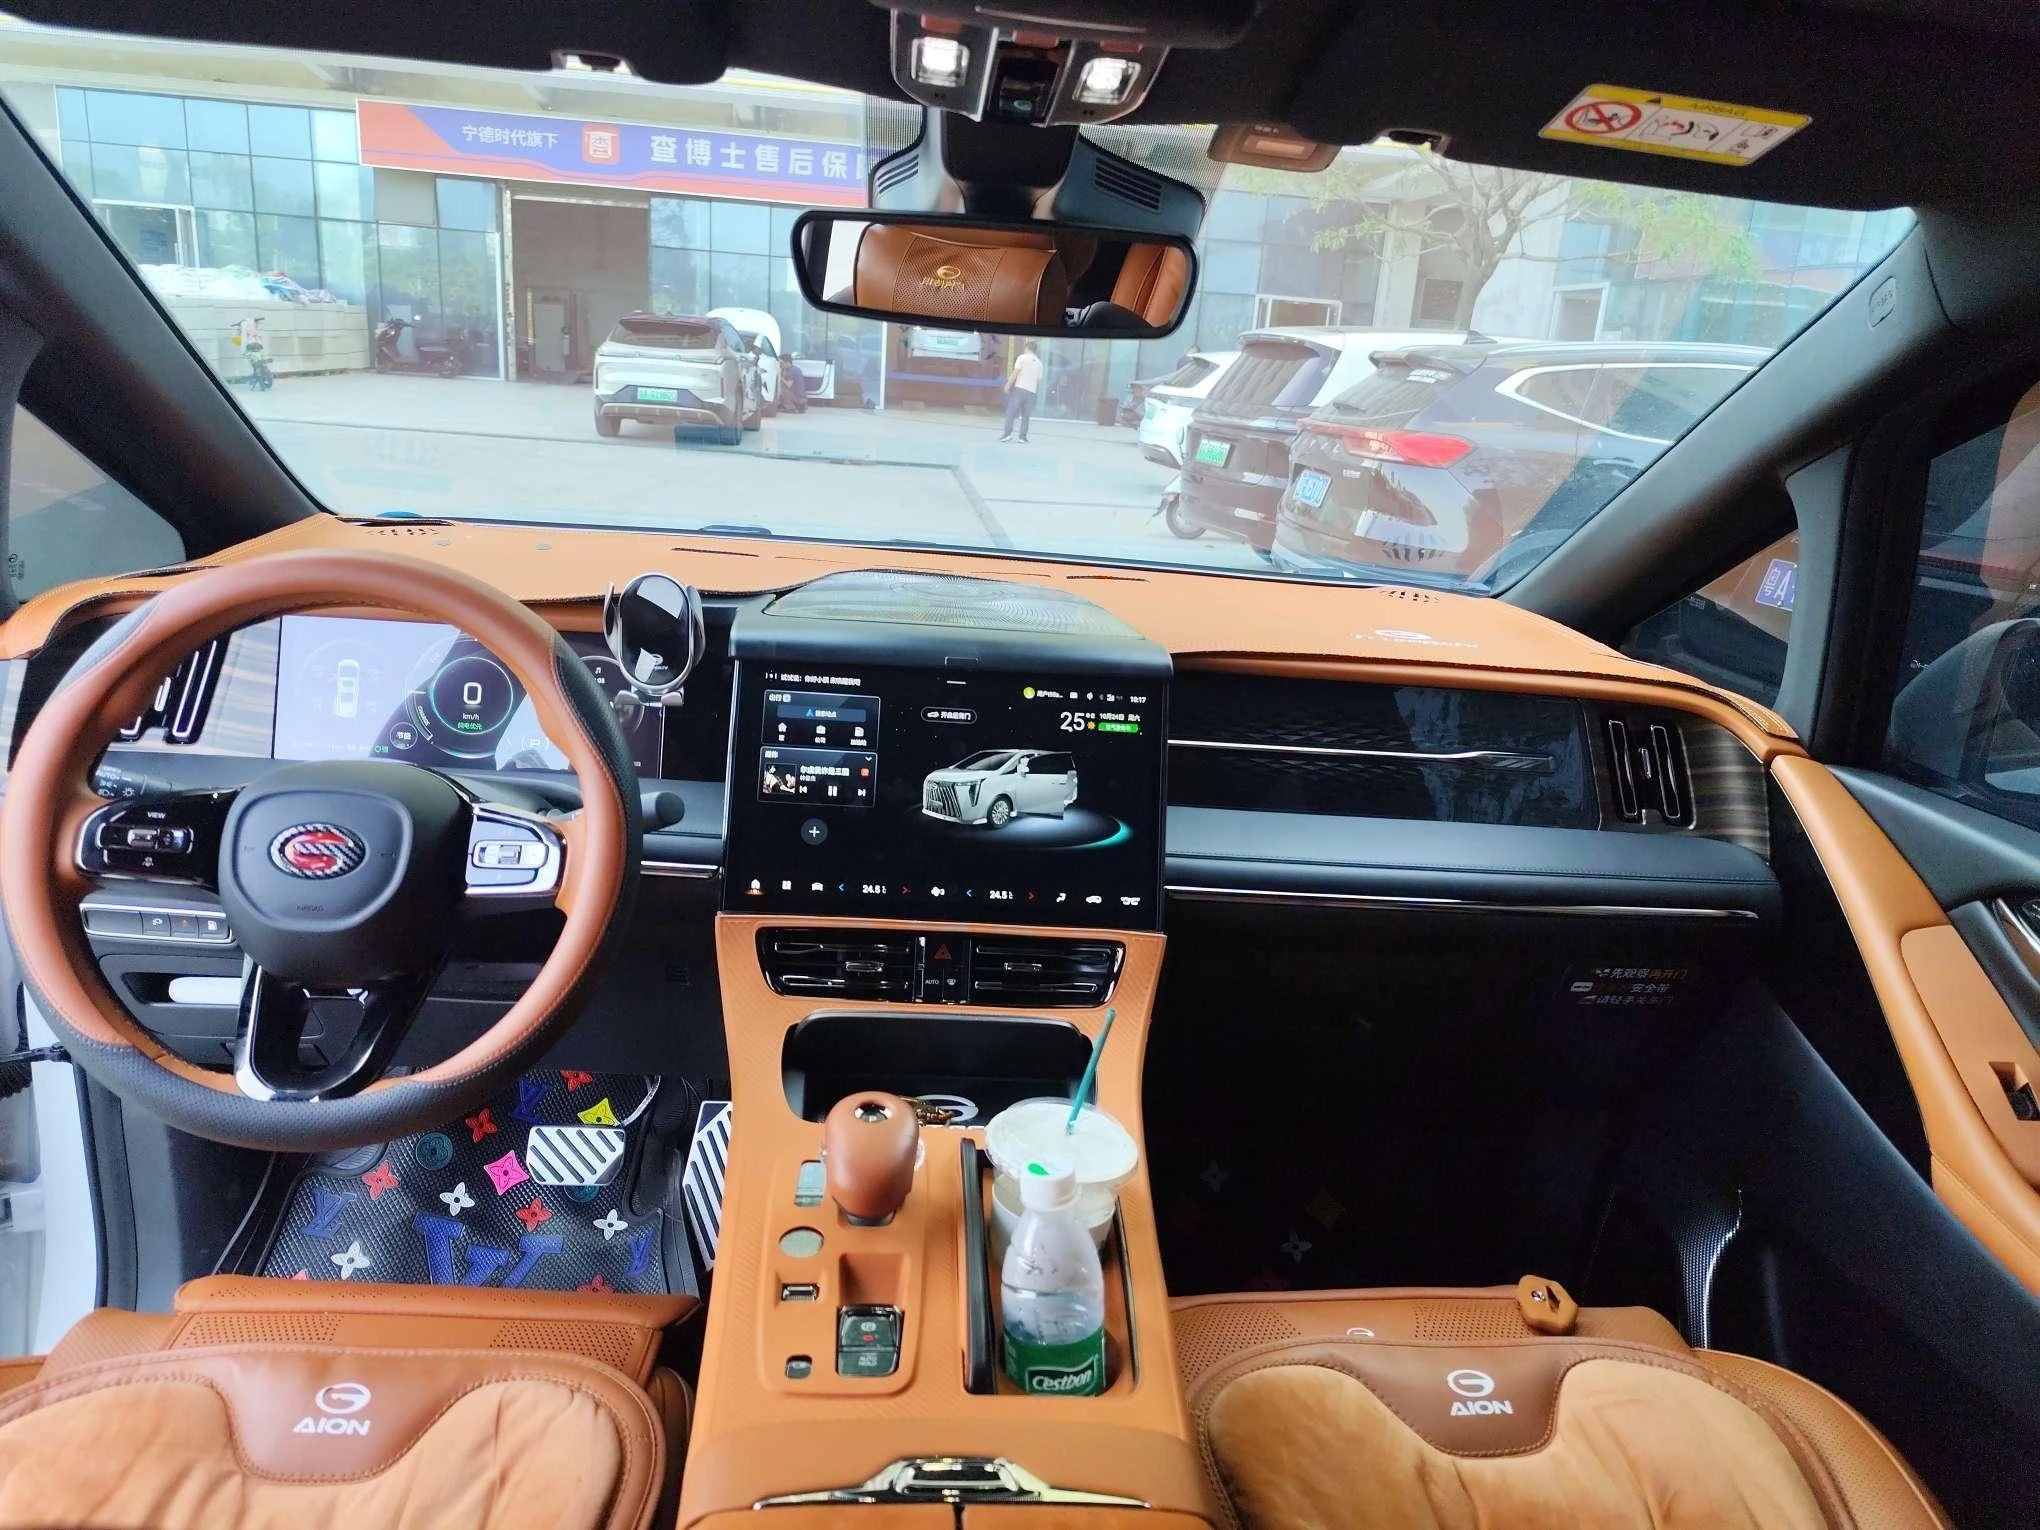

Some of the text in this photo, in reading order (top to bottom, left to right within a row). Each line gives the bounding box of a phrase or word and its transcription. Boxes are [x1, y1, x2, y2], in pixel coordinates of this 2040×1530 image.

[461, 124, 560, 149] 宁德时代旗下
[650, 135, 865, 181] 查博士售后保
[463, 682, 482, 705] 0
[462, 712, 480, 720] km/h
[147, 811, 166, 819] VIEW
[862, 885, 881, 894] 24.5
[989, 890, 1008, 899] 24.5
[1450, 1400, 1513, 1417] AION
[292, 1416, 372, 1437] AION
